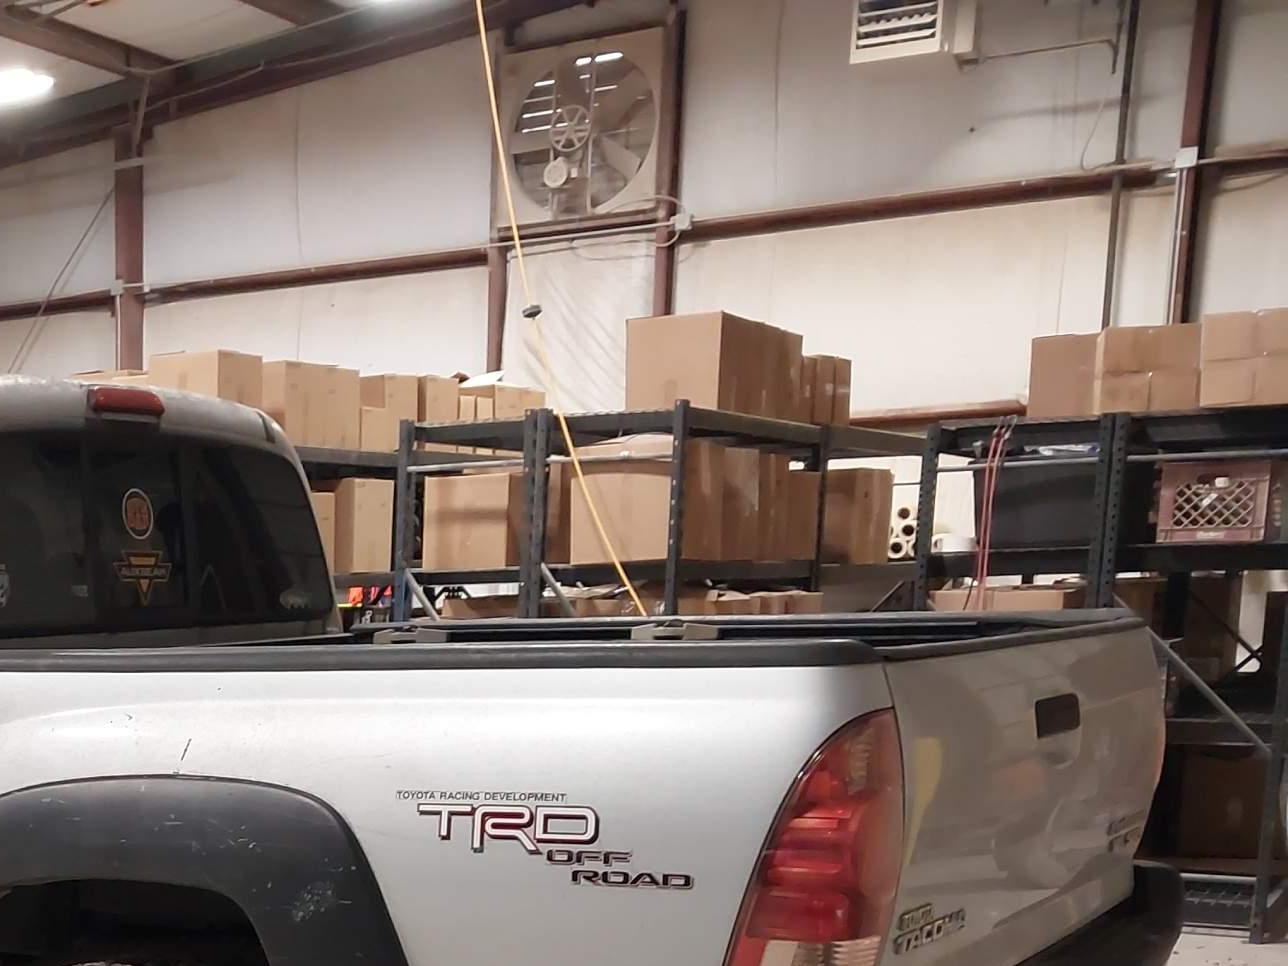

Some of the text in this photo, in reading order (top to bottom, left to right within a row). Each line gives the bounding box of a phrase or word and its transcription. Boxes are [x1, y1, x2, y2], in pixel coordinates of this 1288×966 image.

[397, 790, 567, 802] TOYOTA RACING DEVELOPMENT
[417, 803, 600, 855] TRD
[546, 849, 632, 866] OFF
[571, 870, 695, 889] ROAD
